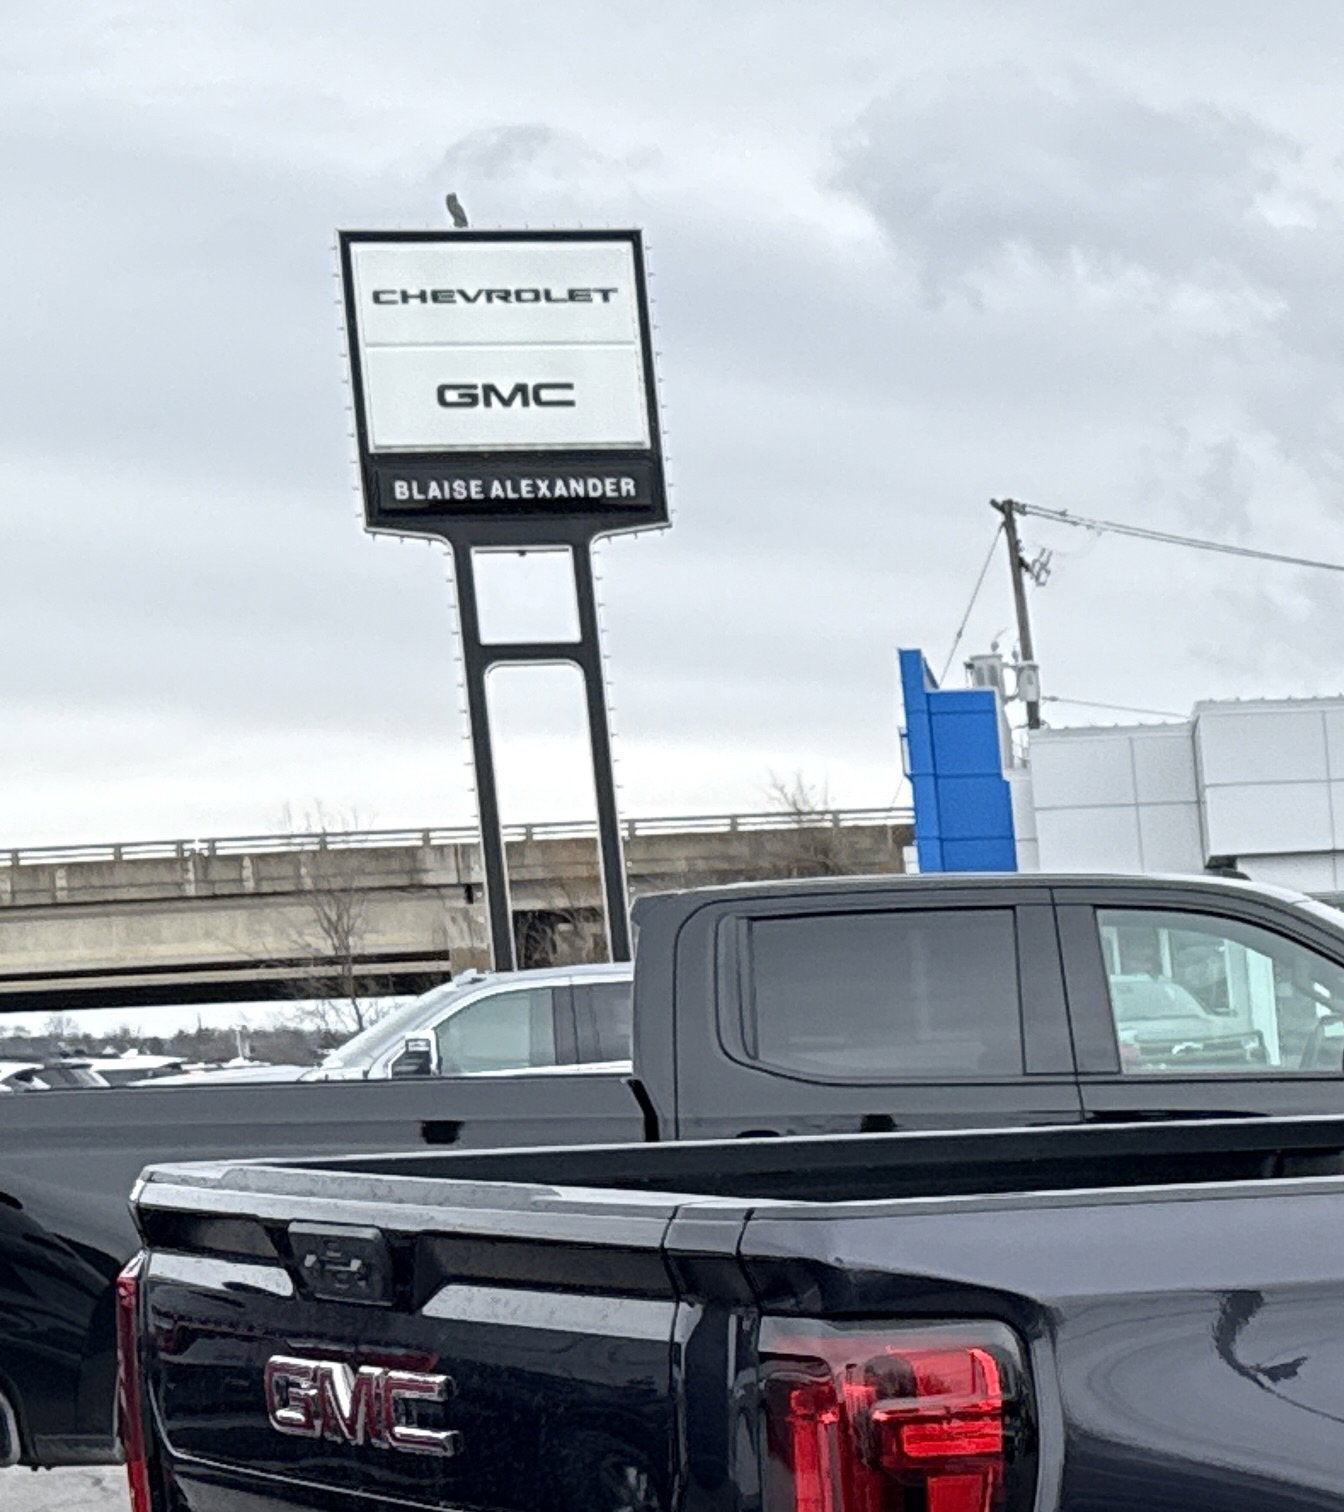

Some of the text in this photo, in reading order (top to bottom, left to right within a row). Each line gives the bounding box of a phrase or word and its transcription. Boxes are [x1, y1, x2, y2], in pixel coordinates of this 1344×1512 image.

[371, 287, 619, 305] CHEVROLET
[436, 382, 576, 408] GMC
[393, 477, 637, 501] BLAISE ALEXANDER
[264, 1355, 461, 1458] GMC
